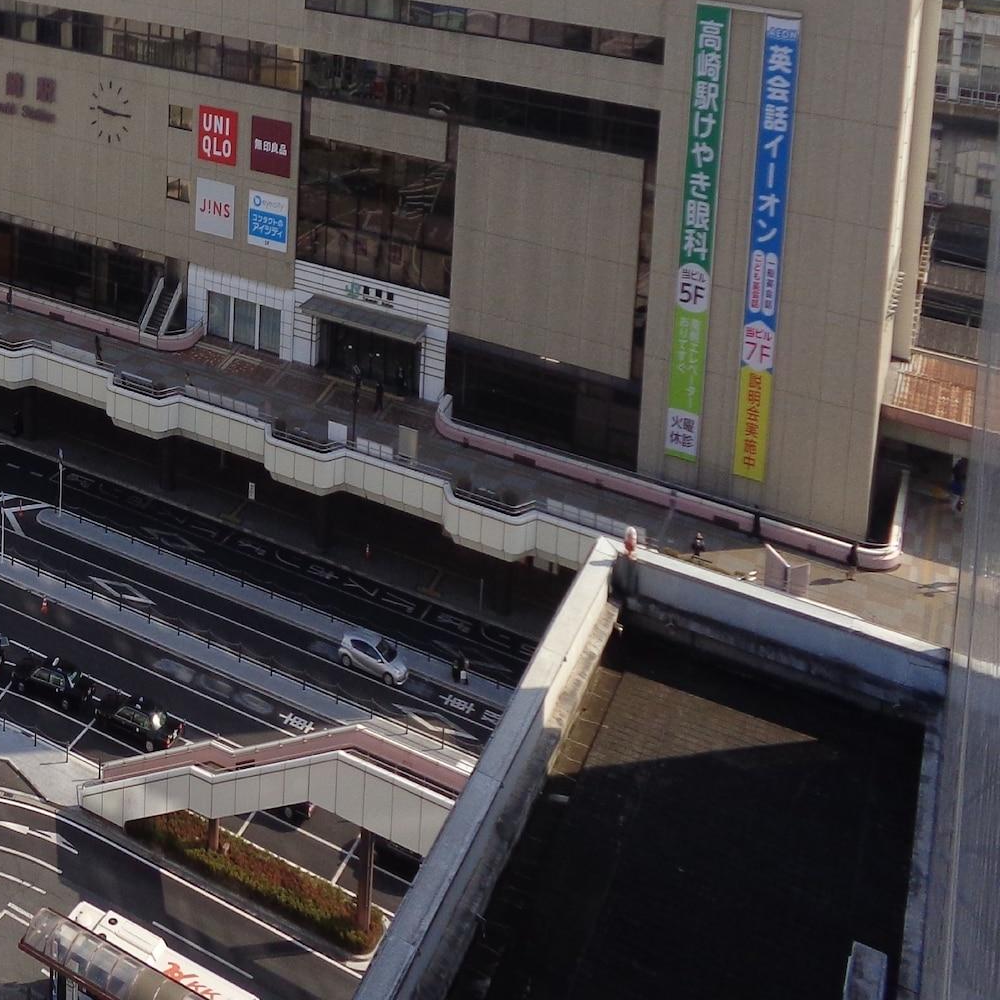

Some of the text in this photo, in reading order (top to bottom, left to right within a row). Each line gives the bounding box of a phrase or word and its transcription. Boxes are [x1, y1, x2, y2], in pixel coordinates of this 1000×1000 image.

[203, 112, 230, 136] UNI
[202, 135, 232, 158] QLO
[254, 138, 288, 156] 無印良品
[684, 19, 724, 261] 高崎駅けやき眼科
[757, 45, 793, 243] 英会話イーオン
[681, 267, 707, 284] 当ビル
[679, 282, 705, 305] 5F
[745, 326, 773, 343] 当ビル
[744, 341, 772, 364] 7F
[670, 415, 696, 433] 火曜
[669, 431, 694, 449] 休診
